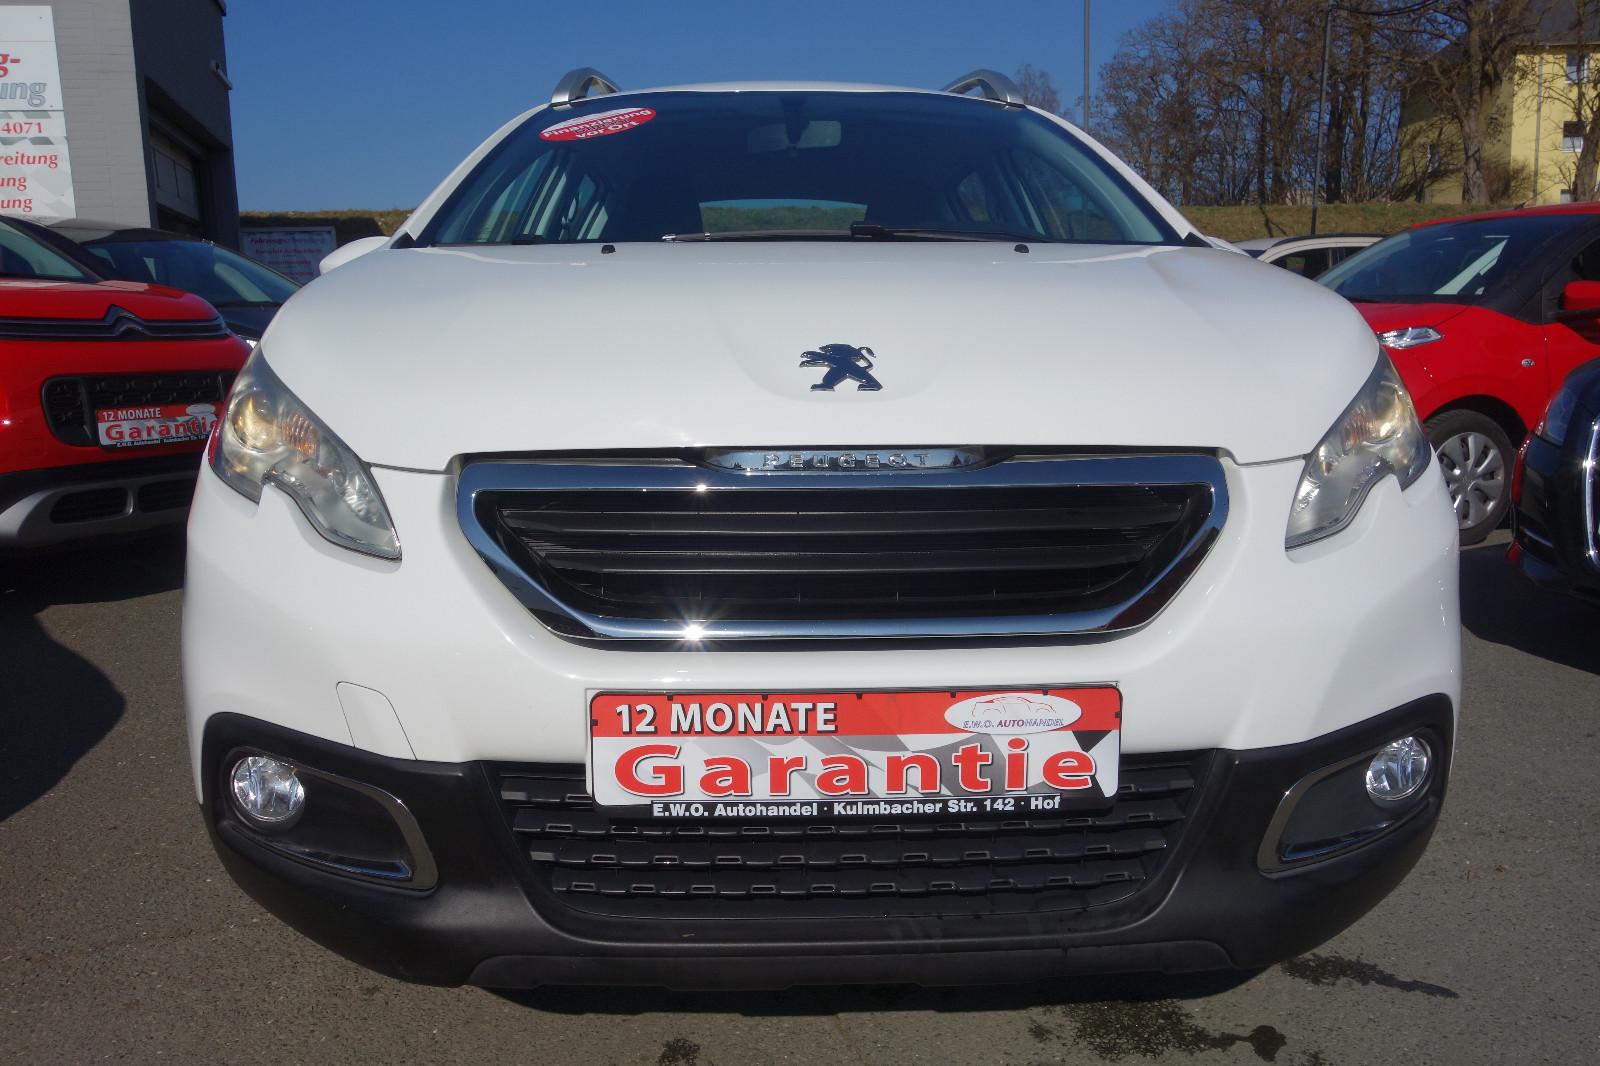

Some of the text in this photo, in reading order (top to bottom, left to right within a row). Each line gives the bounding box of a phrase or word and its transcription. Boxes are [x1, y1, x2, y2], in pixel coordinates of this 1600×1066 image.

[102, 408, 161, 420] 12 MONATE
[763, 453, 930, 468] PEUGEOT
[615, 702, 838, 733] 12 MONATE
[613, 737, 1096, 797] Garantie
[652, 796, 1061, 817] E.W.O. Autohandel Kulmbacher Str. 142 Hof
